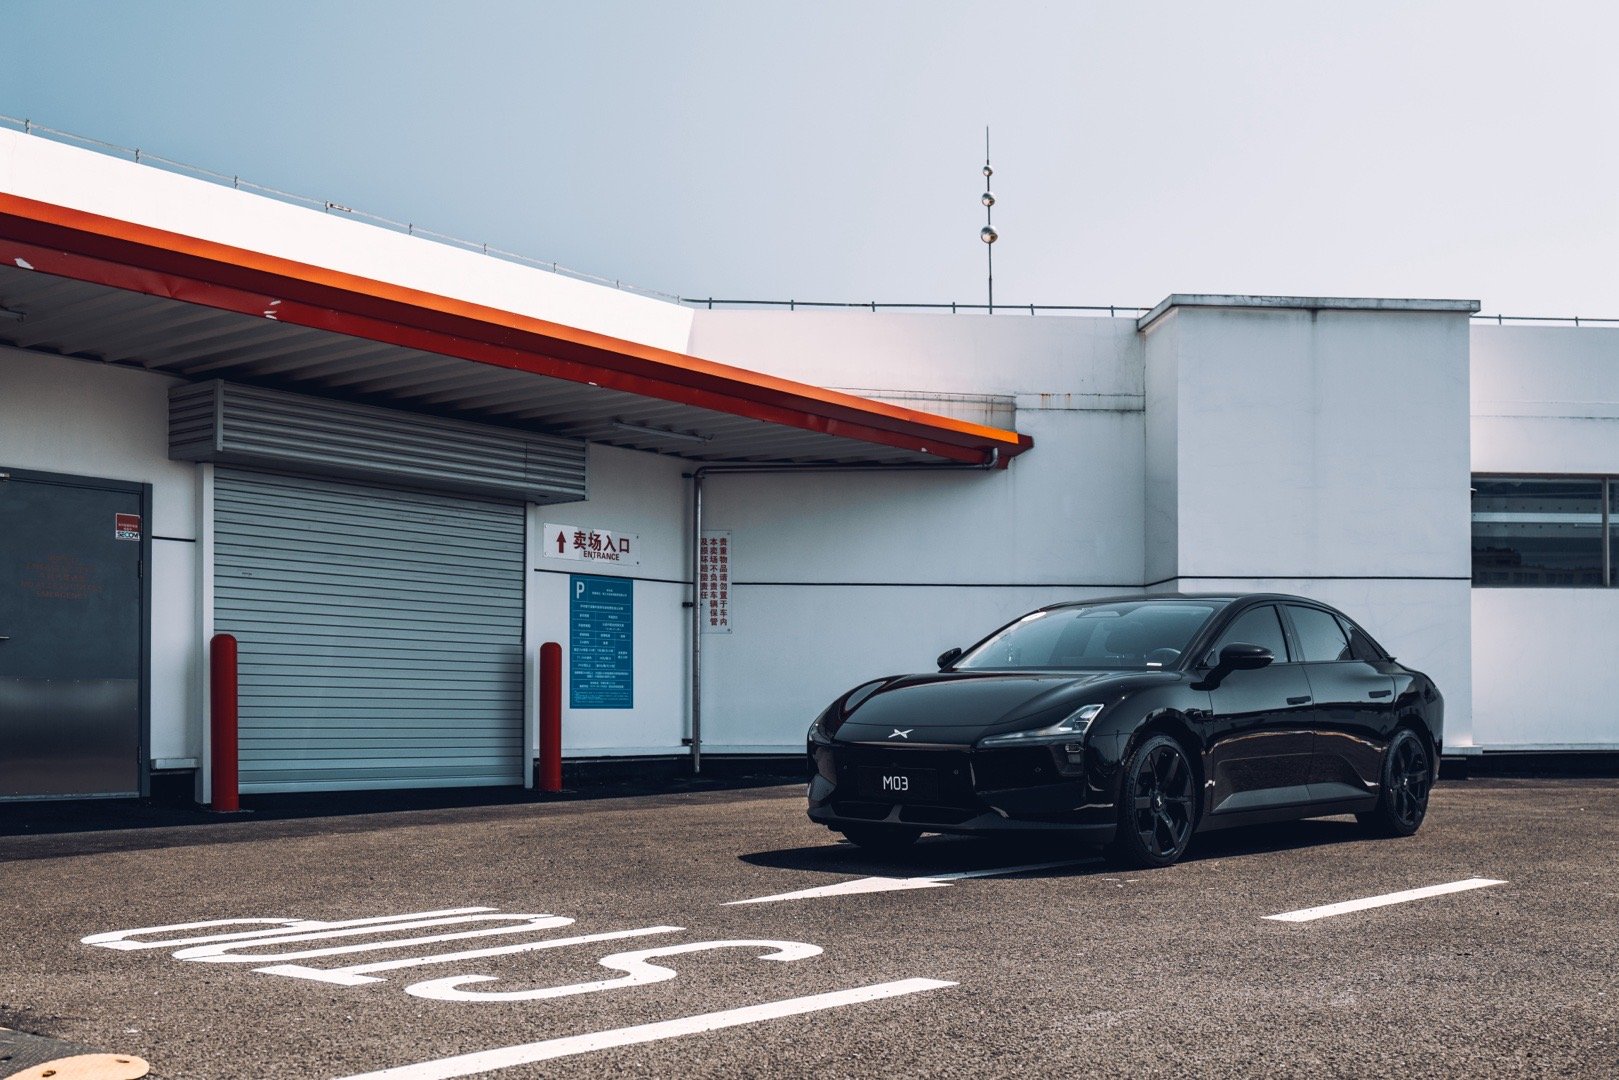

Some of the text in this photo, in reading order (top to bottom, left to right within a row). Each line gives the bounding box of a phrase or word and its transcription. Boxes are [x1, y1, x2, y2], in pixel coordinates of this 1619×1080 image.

[573, 530, 629, 553] 卖场入口
[583, 550, 620, 560] ENTRANCE
[576, 581, 585, 600] P
[882, 775, 909, 791] M03
[80, 906, 824, 1002] STOP
